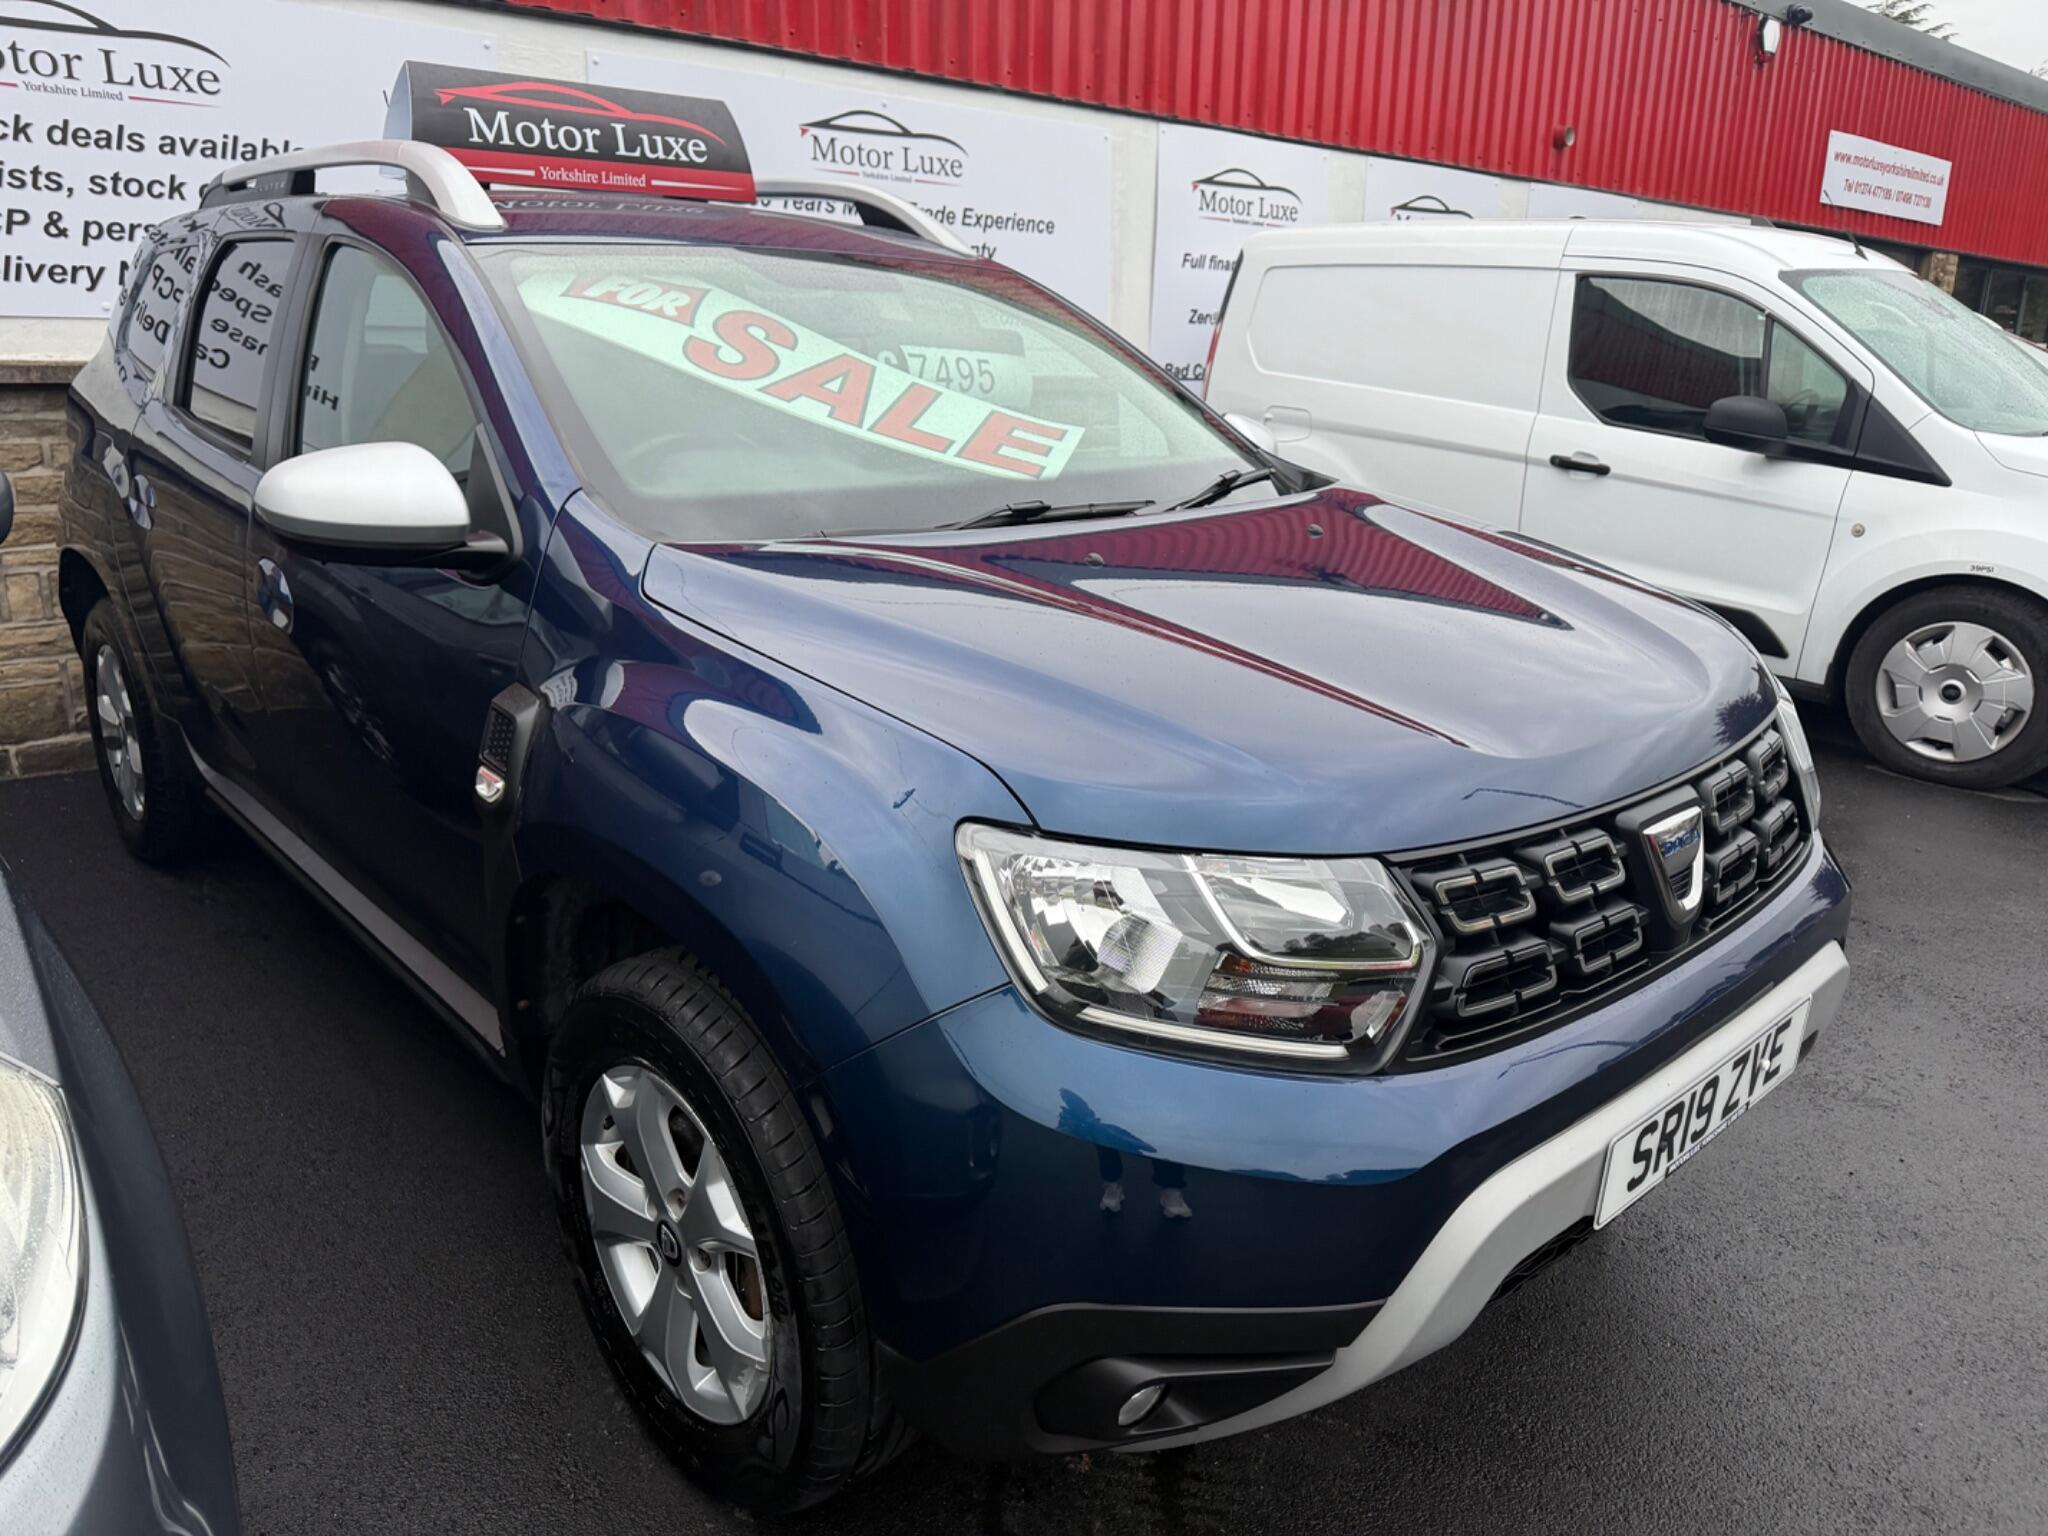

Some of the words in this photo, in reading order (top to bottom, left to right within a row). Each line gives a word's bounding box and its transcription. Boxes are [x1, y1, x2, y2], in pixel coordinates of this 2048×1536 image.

[97, 48, 222, 96] Luxe
[22, 80, 78, 97] Yorkshire
[80, 86, 124, 101] Limited
[47, 119, 145, 153] deals
[463, 107, 600, 154] Motor
[610, 122, 708, 164] Luxe
[811, 135, 893, 170] Motor
[902, 147, 964, 178] Luxe
[88, 171, 187, 200] stock
[539, 166, 598, 185] Yorkshire
[601, 171, 646, 188] Limited
[961, 207, 1055, 235] Experience
[1198, 189, 1254, 217] Motor
[1258, 197, 1299, 223] Luxe
[43, 210, 69, 239] &
[1181, 253, 1206, 270] Full
[584, 275, 690, 316] FOR
[683, 309, 1068, 480] SALE
[1626, 1074, 1720, 1193] SR19
[1720, 1017, 1792, 1121] ZVE
